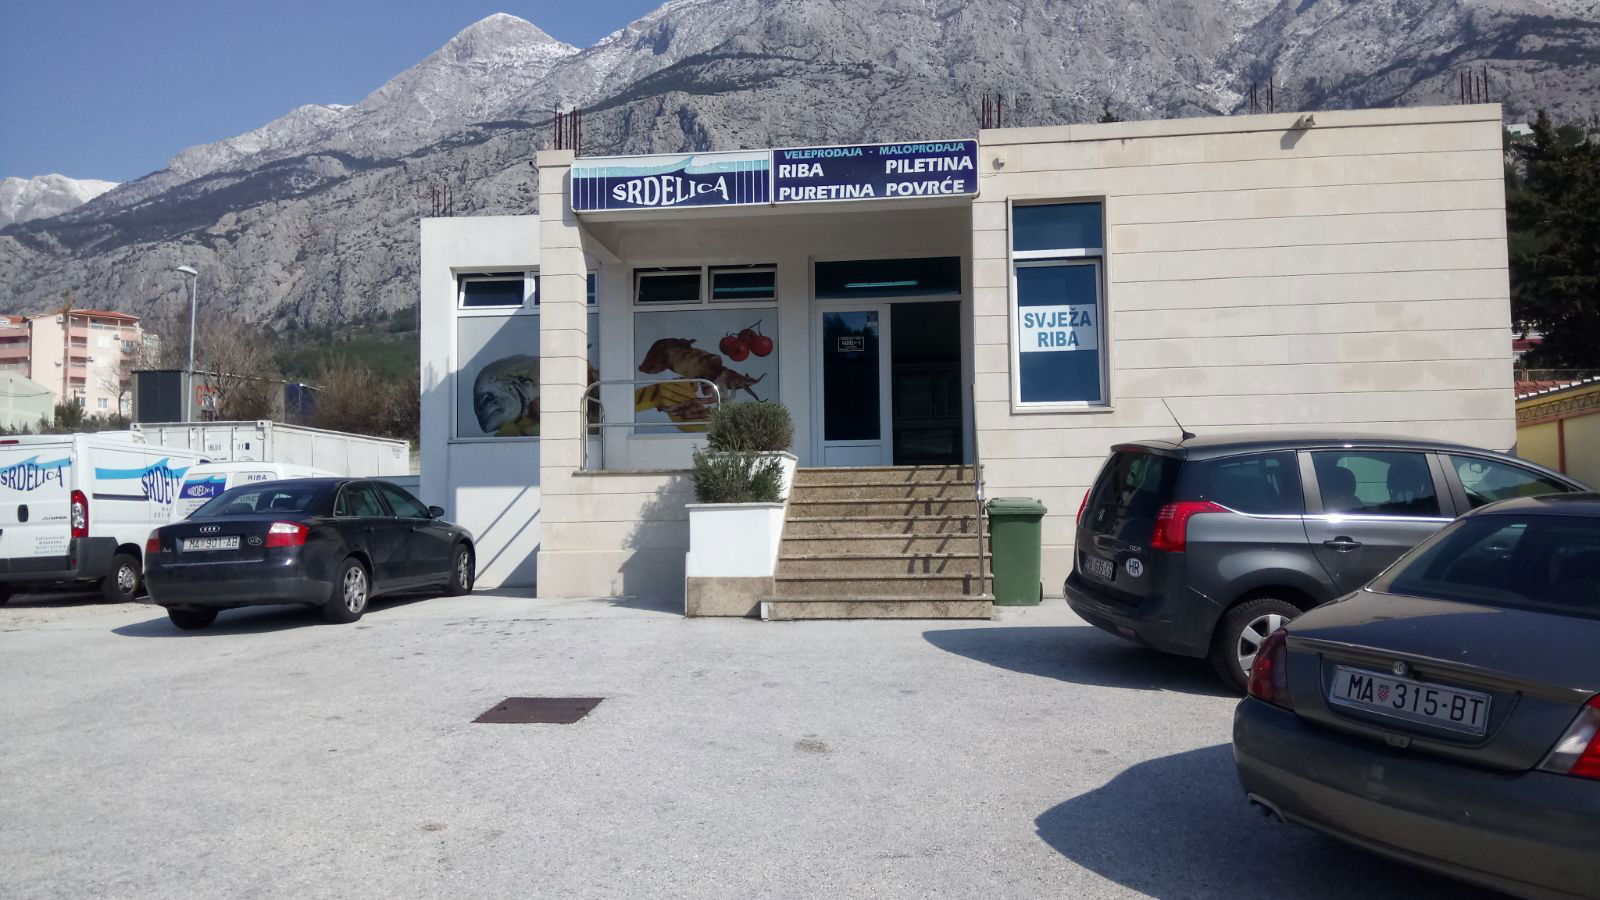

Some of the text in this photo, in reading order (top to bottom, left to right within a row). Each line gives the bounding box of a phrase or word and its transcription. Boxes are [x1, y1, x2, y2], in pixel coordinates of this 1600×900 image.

[784, 148, 863, 159] VELEPRODAJA
[879, 143, 965, 155] MALOPRODAJA
[779, 156, 974, 178] RIBA PILETINA
[779, 176, 965, 200] PURETINA POVRĆE
[1024, 308, 1092, 328] SVJEŽA
[1038, 331, 1080, 347] RIBA
[1128, 560, 1140, 575] HR
[1347, 674, 1484, 724] MA 315-BT
